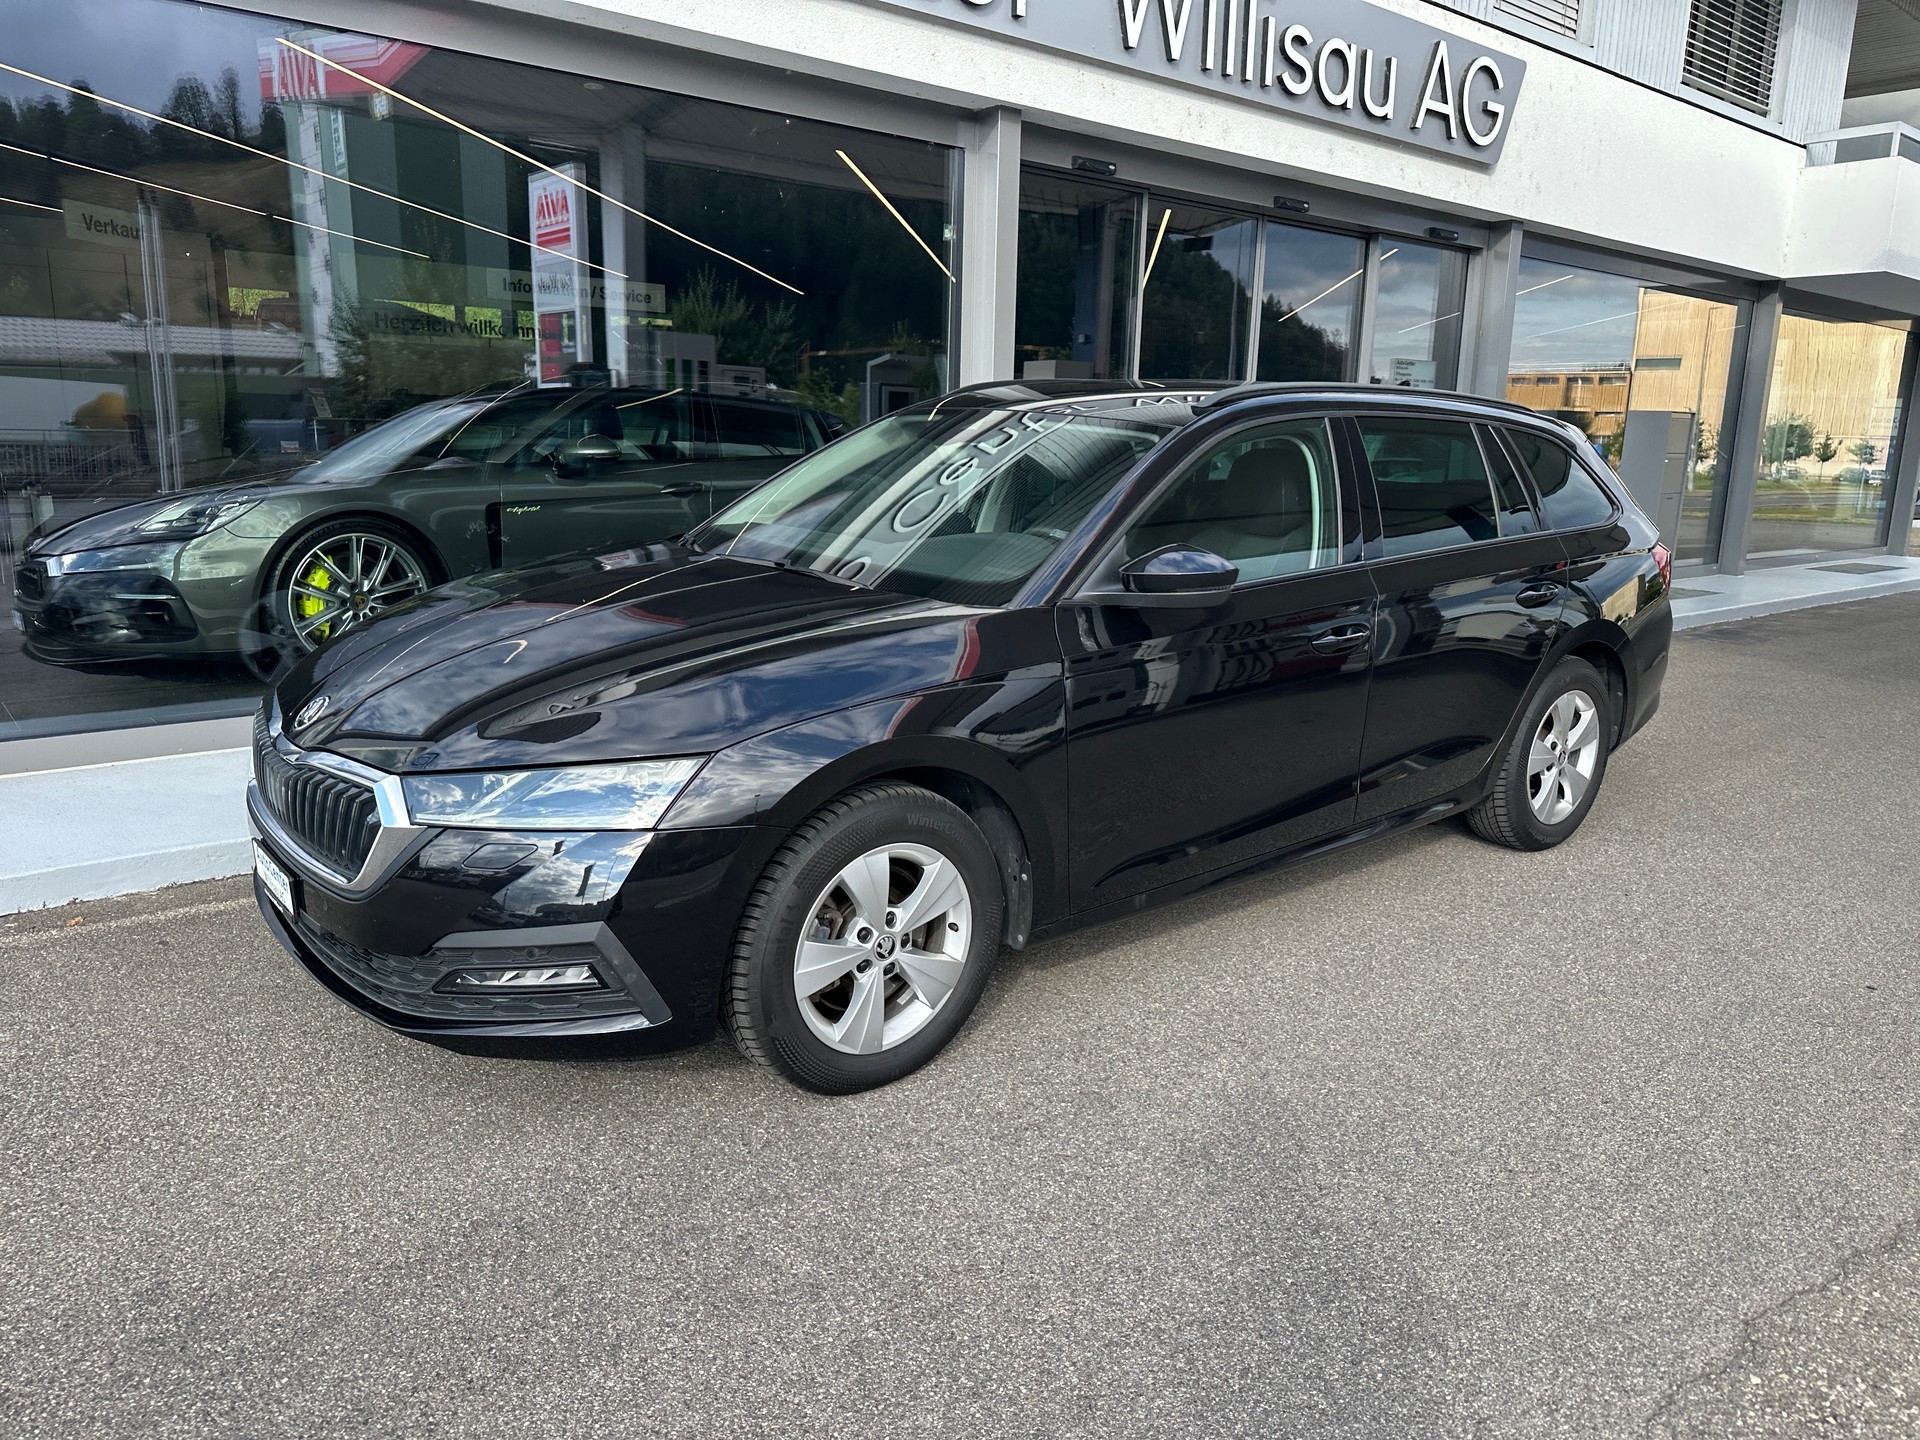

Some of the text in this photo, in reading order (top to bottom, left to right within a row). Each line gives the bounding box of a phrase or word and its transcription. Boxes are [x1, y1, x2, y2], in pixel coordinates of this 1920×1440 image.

[1117, 0, 1505, 146] Willisau AG
[599, 287, 652, 304] Service
[374, 311, 454, 333] Herzlich
